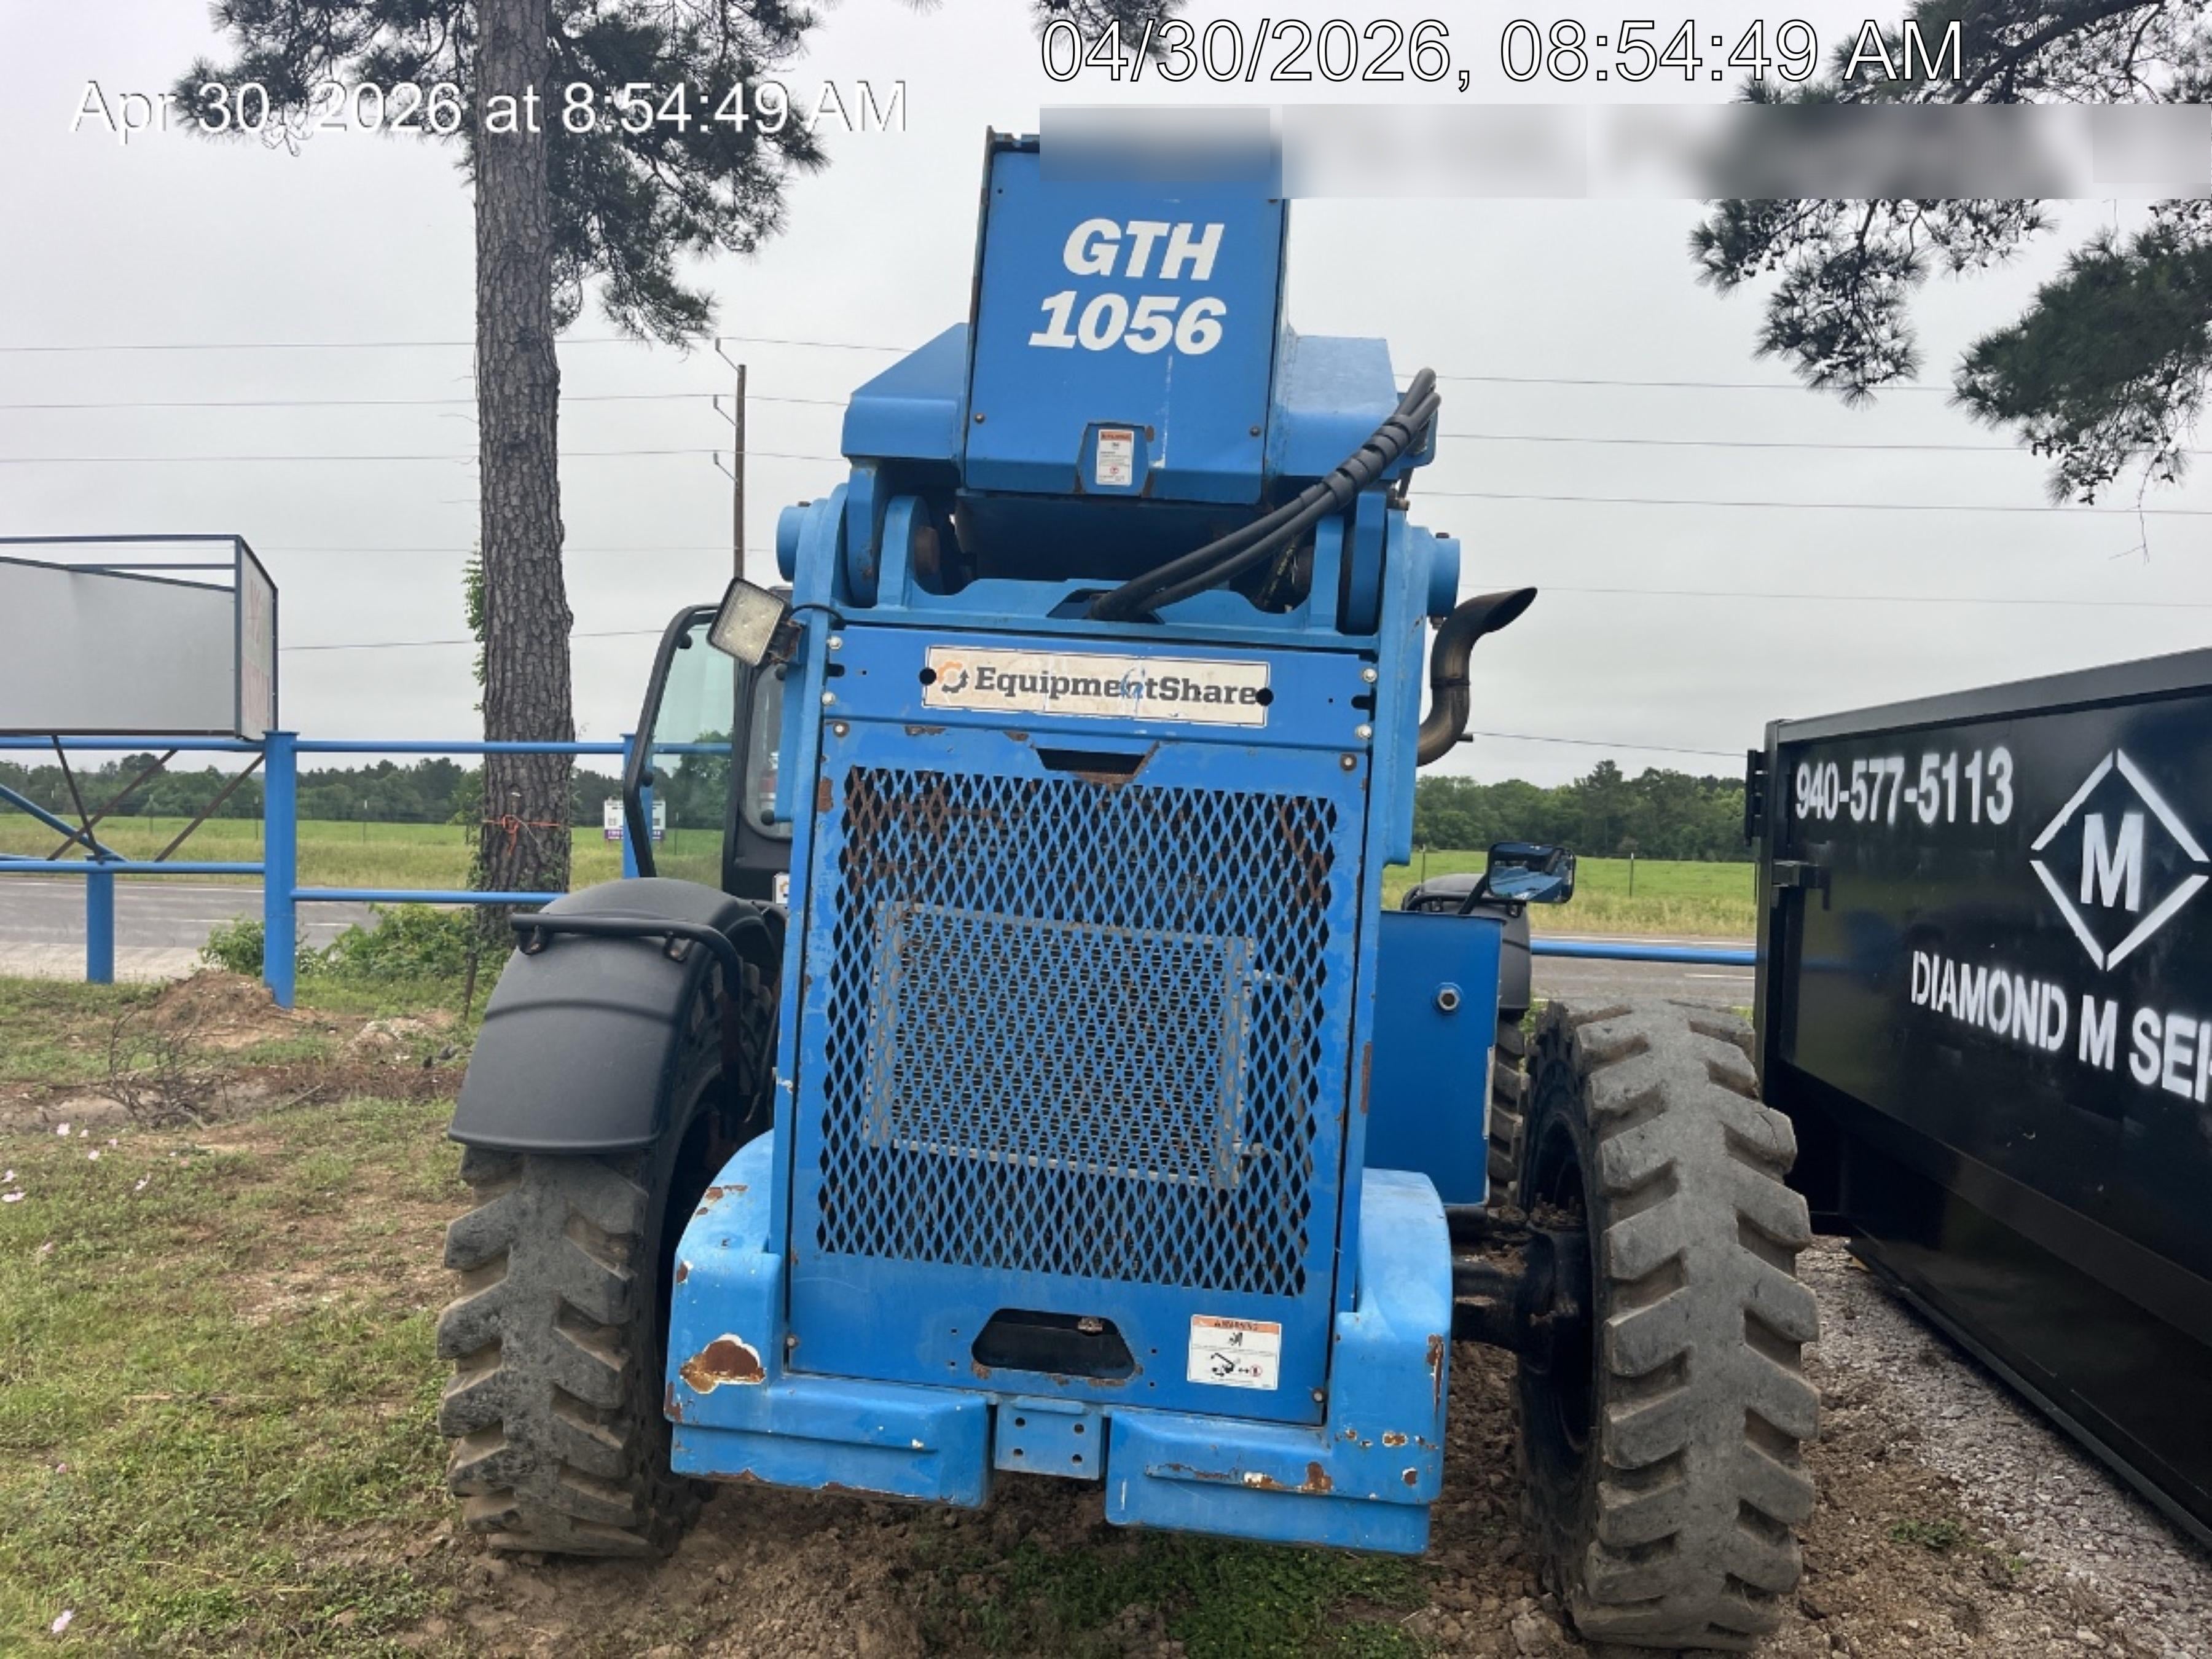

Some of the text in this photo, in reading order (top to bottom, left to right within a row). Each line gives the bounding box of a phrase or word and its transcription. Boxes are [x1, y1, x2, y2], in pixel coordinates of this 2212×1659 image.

[1062, 218, 1225, 281] GTH
[1028, 290, 1227, 355] 1056
[975, 667, 1257, 705] EquipmentShare
[1795, 746, 2014, 827] 940-577-5113
[2080, 812, 2144, 912] M
[1910, 949, 2068, 1053] DIAMOND
[2078, 994, 2119, 1072] M
